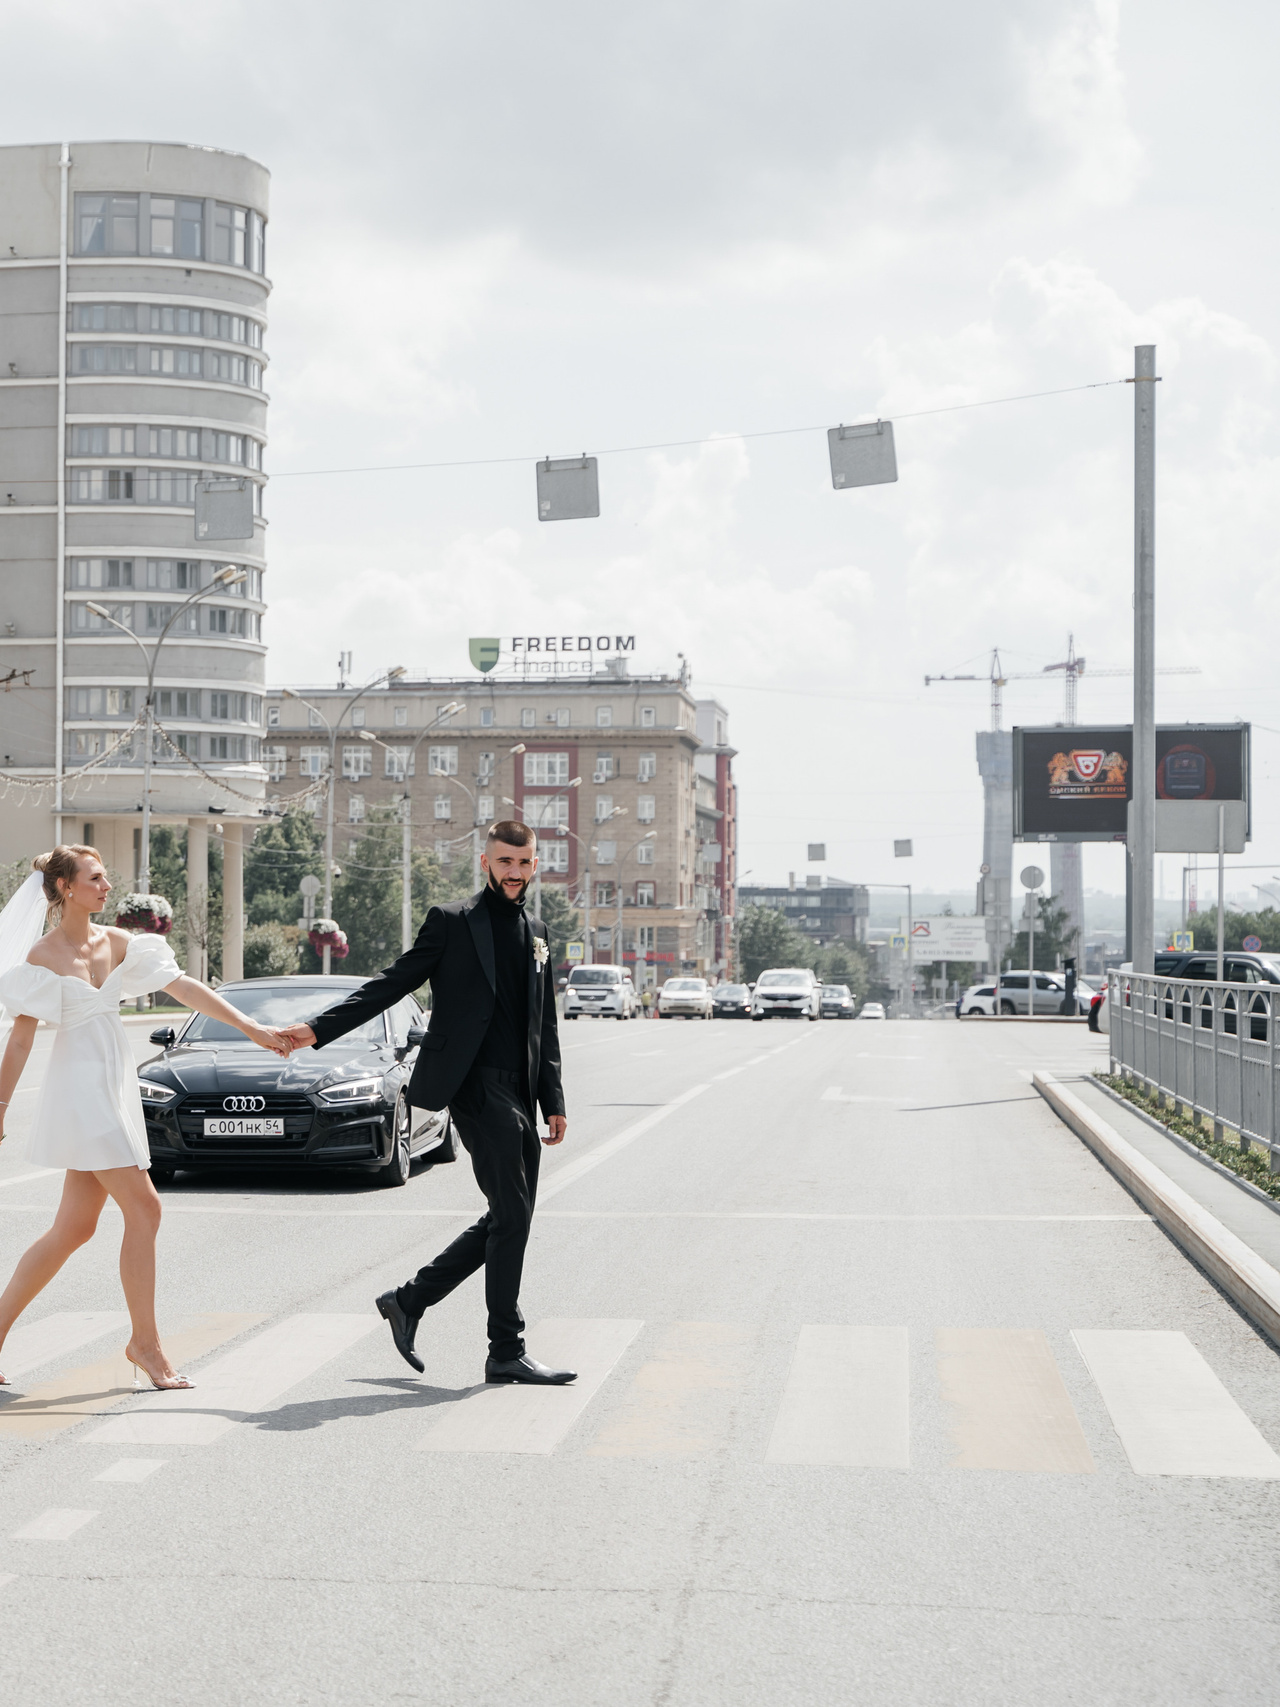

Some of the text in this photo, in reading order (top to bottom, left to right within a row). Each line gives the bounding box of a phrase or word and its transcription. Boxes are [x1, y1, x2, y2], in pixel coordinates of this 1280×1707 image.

[512, 636, 635, 652] FREEDOM
[514, 657, 593, 673] finance
[265, 1119, 279, 1130] 54
